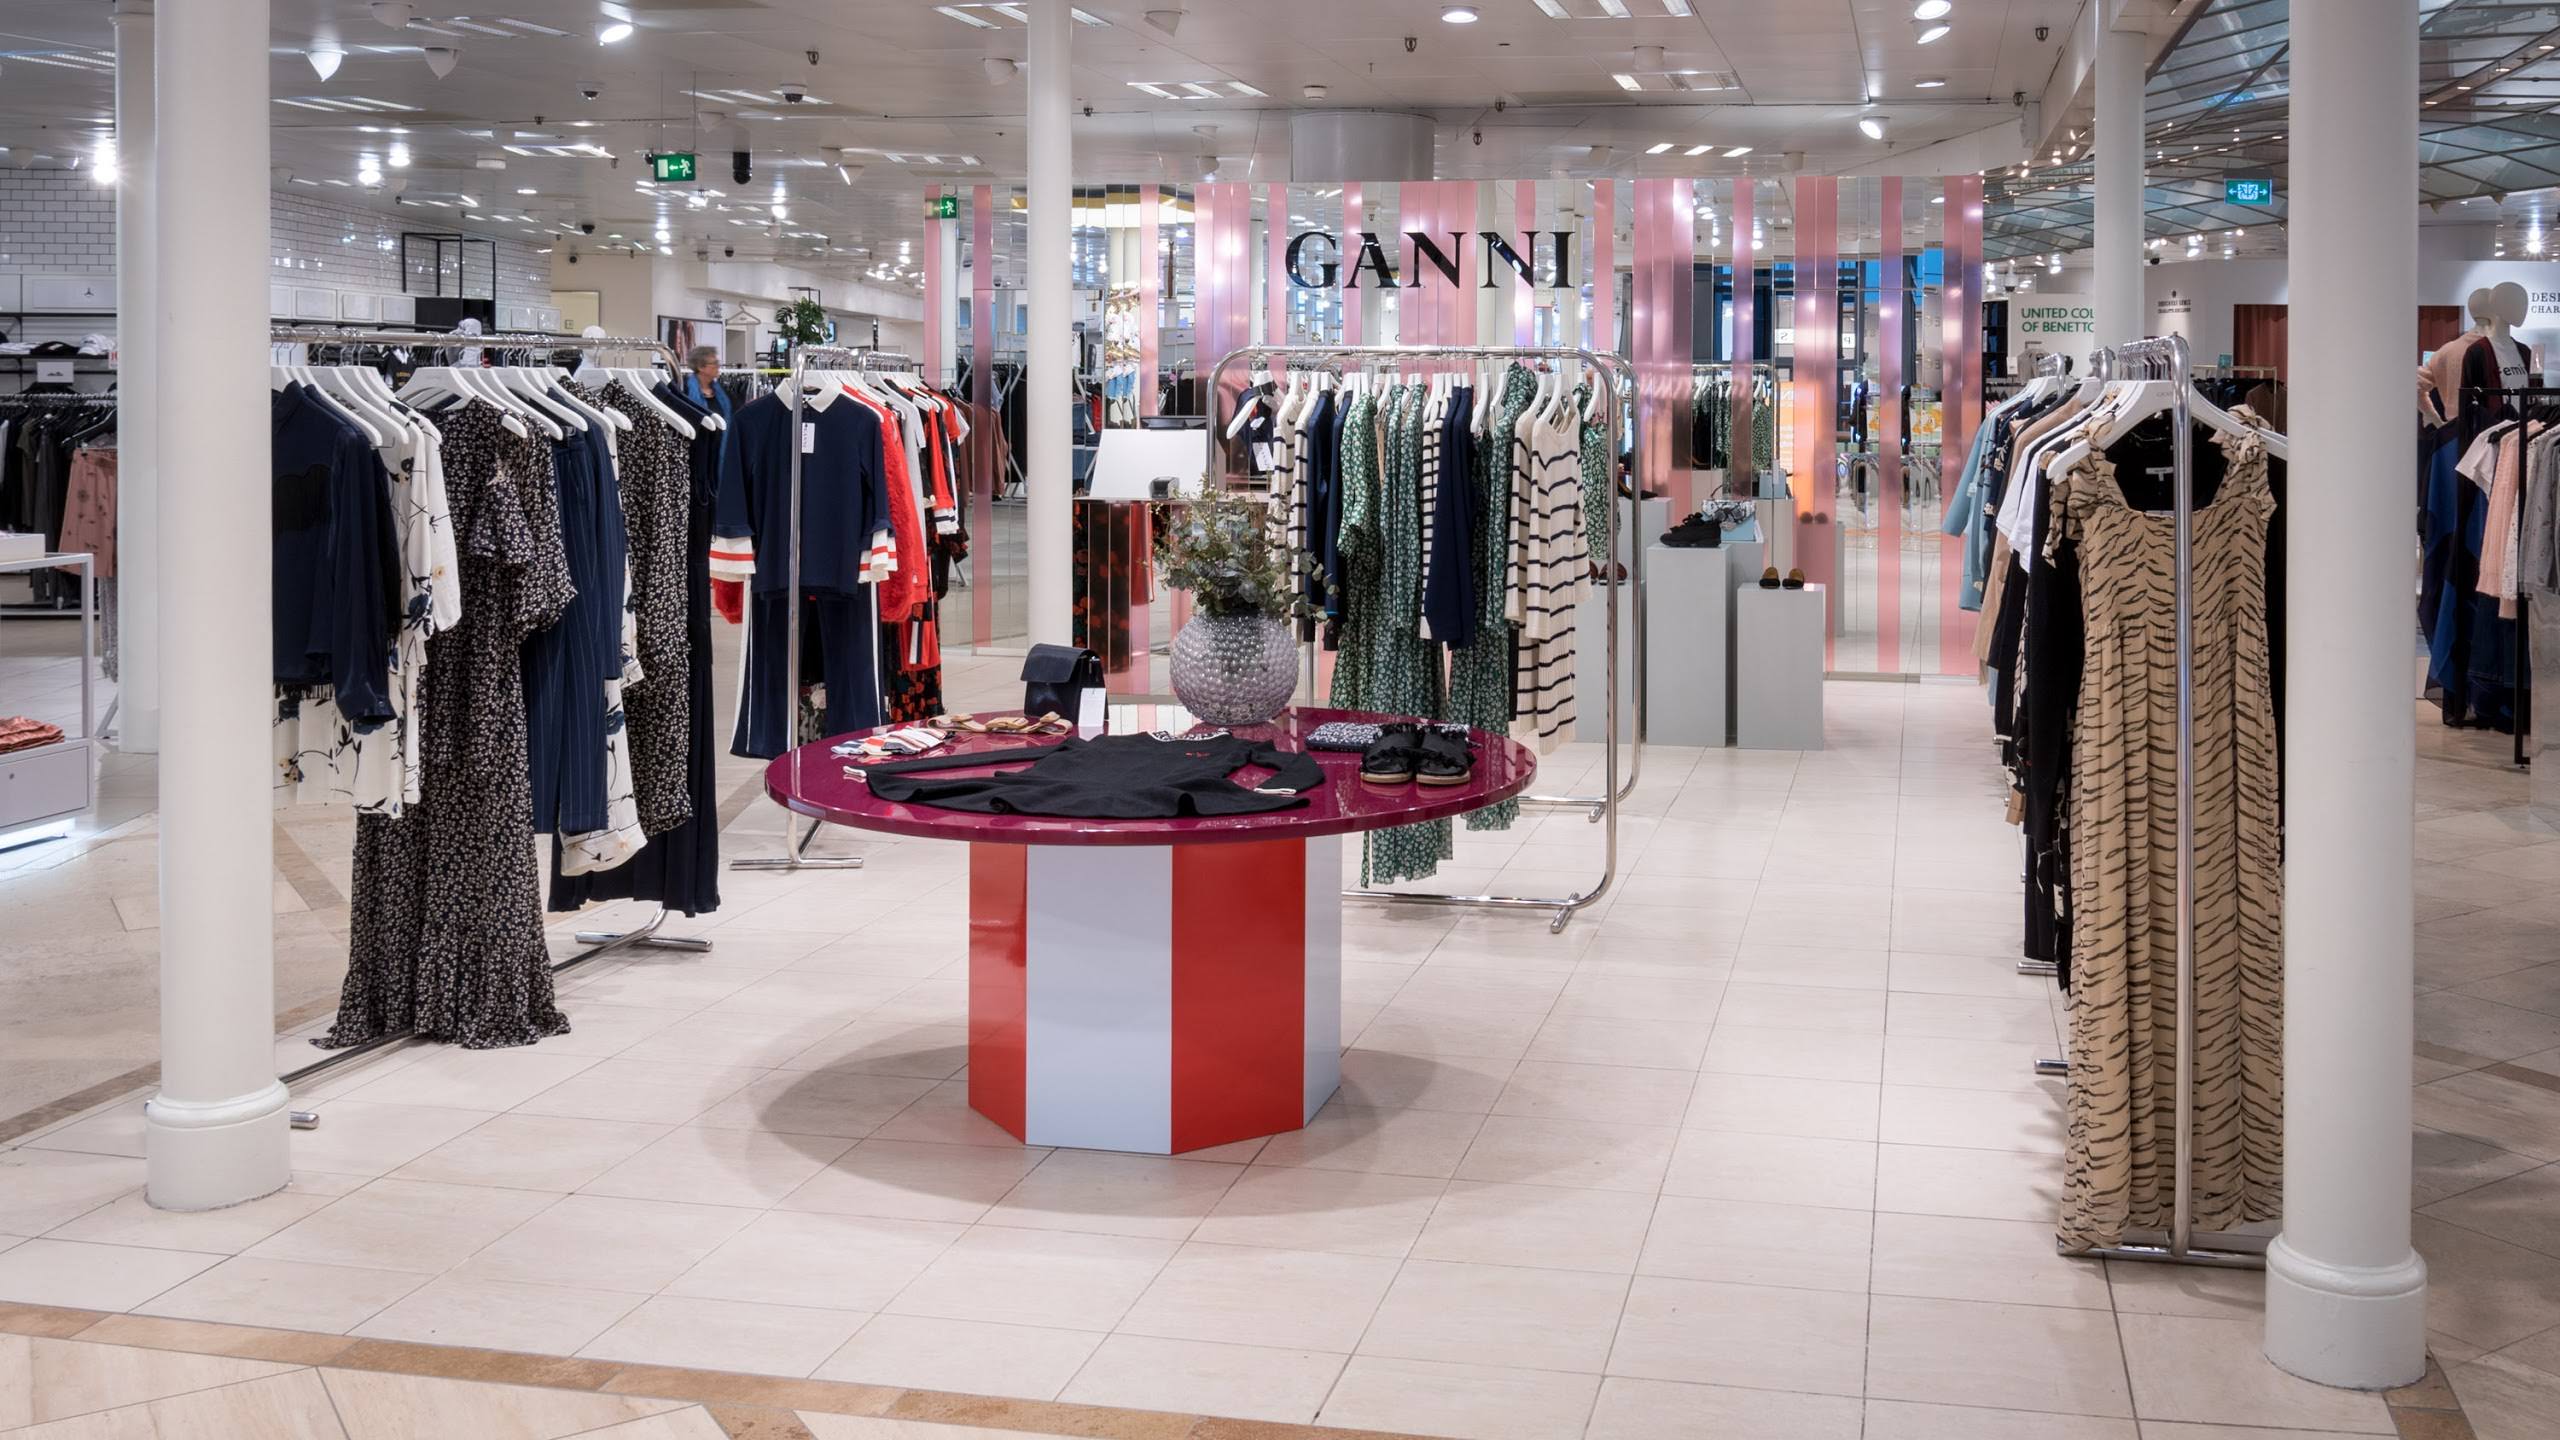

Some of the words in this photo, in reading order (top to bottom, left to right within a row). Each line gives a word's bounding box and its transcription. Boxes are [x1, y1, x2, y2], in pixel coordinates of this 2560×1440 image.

[1286, 231, 1576, 289] GANNI
[2532, 293, 2560, 302] DESI
[2021, 308, 2067, 319] UNITED
[2071, 308, 2094, 319] COL
[2531, 305, 2560, 313] CHAR
[2022, 321, 2039, 333] OF
